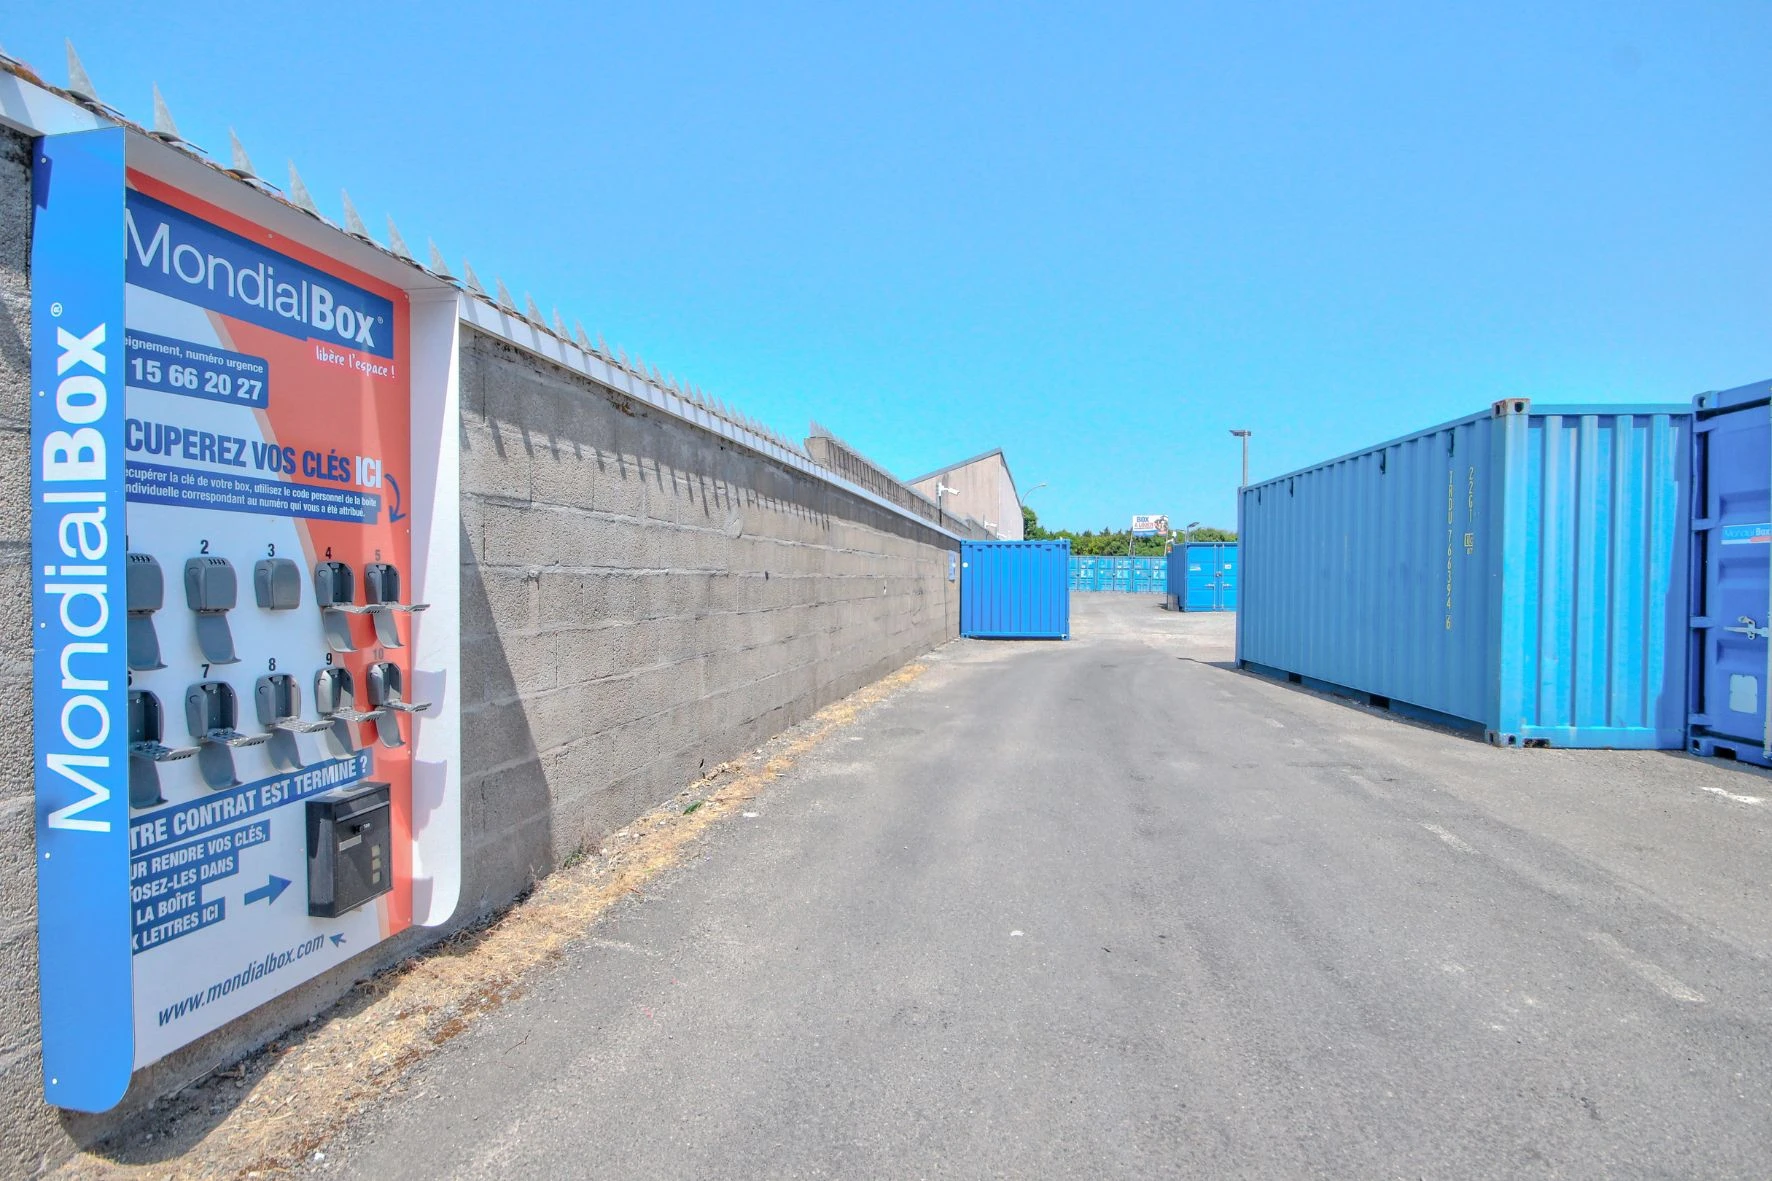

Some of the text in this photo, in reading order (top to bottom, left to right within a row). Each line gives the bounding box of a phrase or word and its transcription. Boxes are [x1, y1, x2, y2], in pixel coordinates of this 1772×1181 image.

[186, 349, 224, 366] numéro
[226, 359, 264, 374] urgence
[316, 345, 345, 365] libère
[349, 353, 388, 376] l'espace
[131, 357, 263, 400] 15 66 20 27
[252, 440, 297, 475] VOS
[302, 449, 352, 483] CLÉS
[355, 455, 382, 488] ICI
[170, 471, 179, 483] la
[181, 473, 195, 485] clé
[197, 475, 209, 487] de
[210, 477, 233, 490] votre
[234, 480, 253, 493] box,
[254, 483, 282, 496] utilisez
[283, 486, 291, 497] le
[292, 488, 310, 499] code
[311, 491, 345, 502] personnel
[345, 494, 354, 504] de
[354, 496, 361, 506] la
[181, 488, 246, 506] correspondant
[247, 497, 258, 506] au
[259, 497, 289, 510] numéro
[290, 500, 302, 513] qui
[303, 503, 320, 513] vous
[321, 505, 326, 513] a
[327, 503, 338, 514] été
[200, 539, 209, 554] 2
[267, 543, 275, 557] 3
[325, 547, 332, 559] 4
[374, 549, 381, 561] 5
[268, 657, 276, 671] 8
[325, 652, 333, 666] 9
[373, 649, 385, 660] 10
[201, 663, 210, 678] 7
[173, 789, 257, 836] CONTRAT
[260, 777, 290, 808] EST
[359, 755, 368, 774] ?
[151, 843, 205, 874] RENDRE
[207, 835, 232, 856] VOS
[234, 825, 266, 847] CLÉS,
[200, 856, 234, 880] DANS
[136, 890, 196, 926] LA BOÎTE
[142, 912, 200, 947] LETTRES
[202, 904, 219, 923] ICI
[158, 934, 325, 1027] www.mondialbox.com
